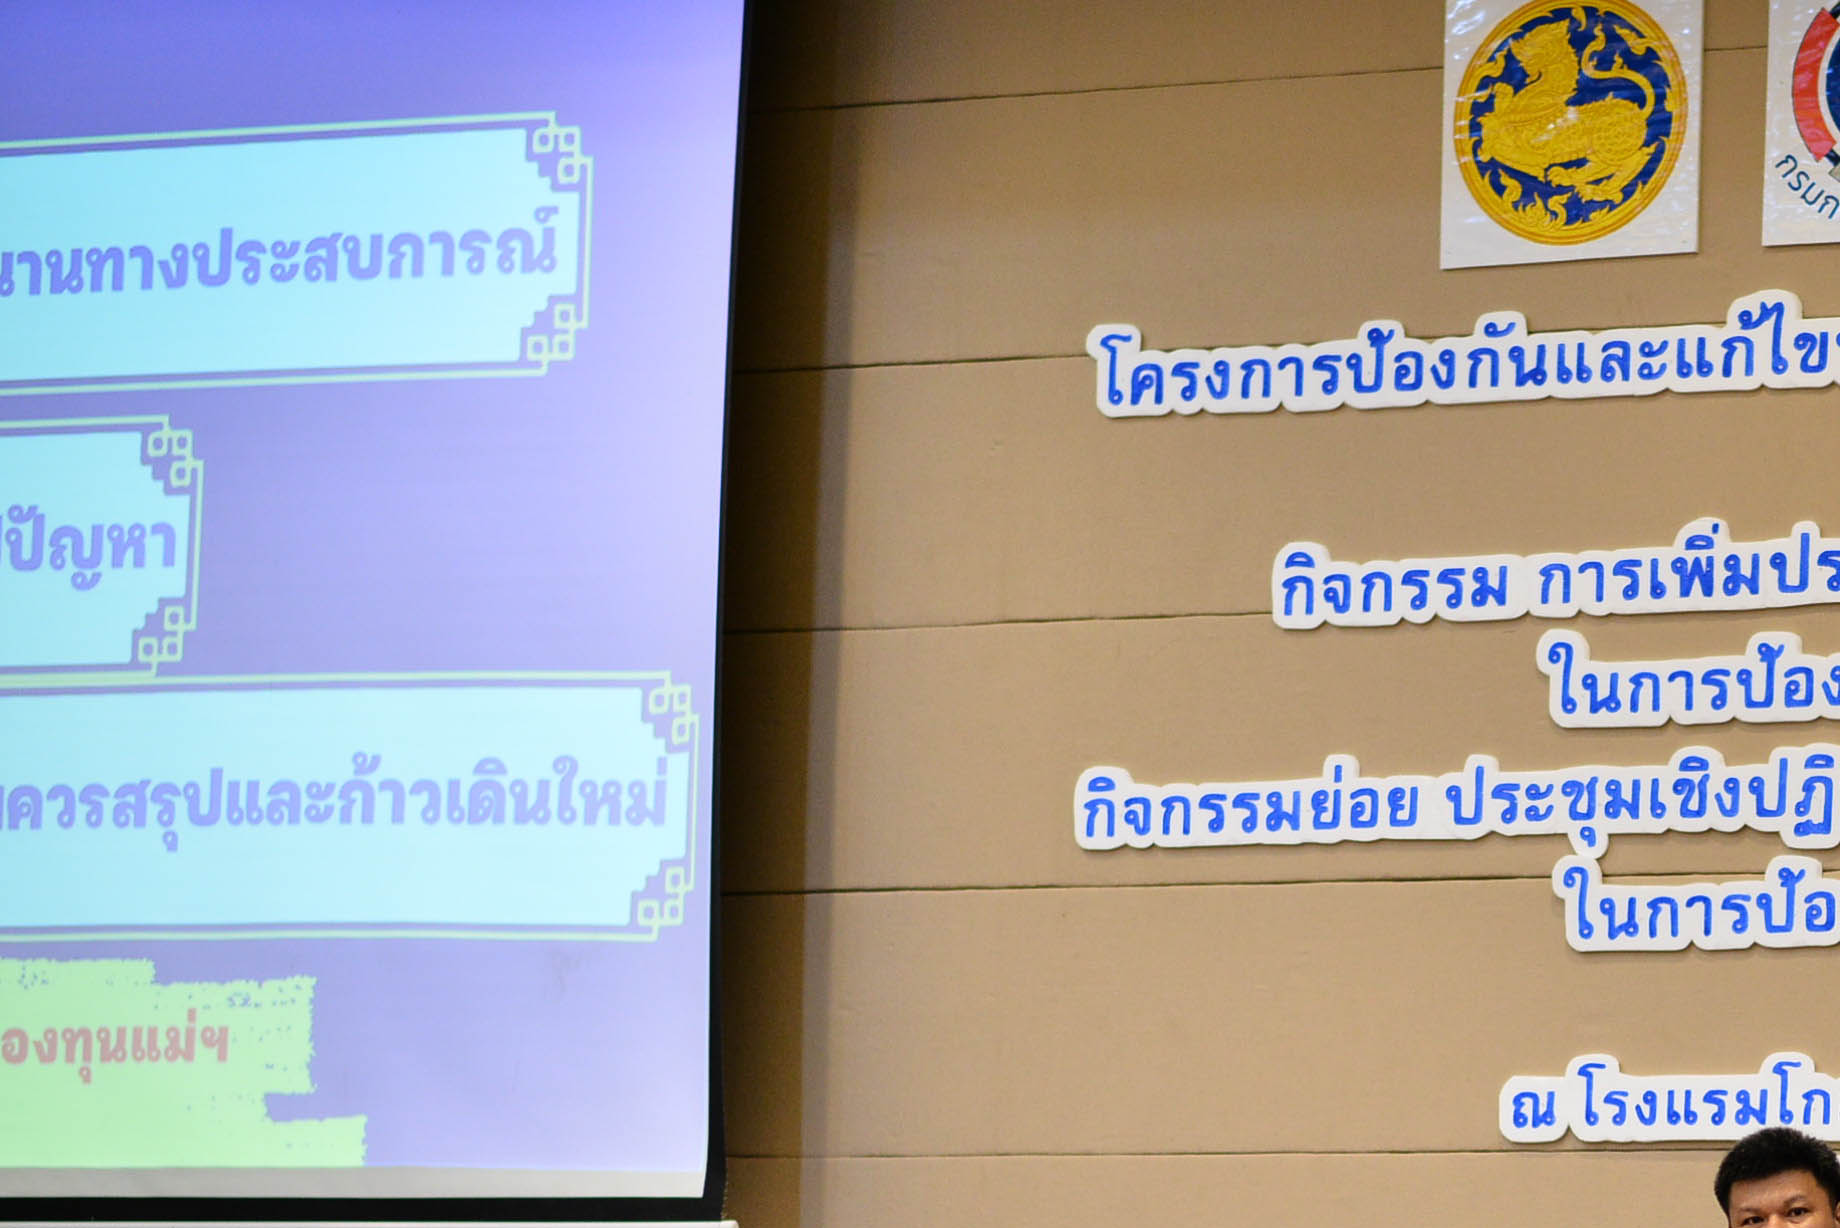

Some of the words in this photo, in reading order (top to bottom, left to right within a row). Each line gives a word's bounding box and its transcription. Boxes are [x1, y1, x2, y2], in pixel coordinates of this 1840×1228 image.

[0, 503, 177, 591] ปัญหา
[1281, 551, 1509, 617] กิจกรรม
[0, 751, 668, 852] ควรสรุปและก้าวเดินใหม่
[1083, 763, 1420, 839] กิจกรรมย่อย
